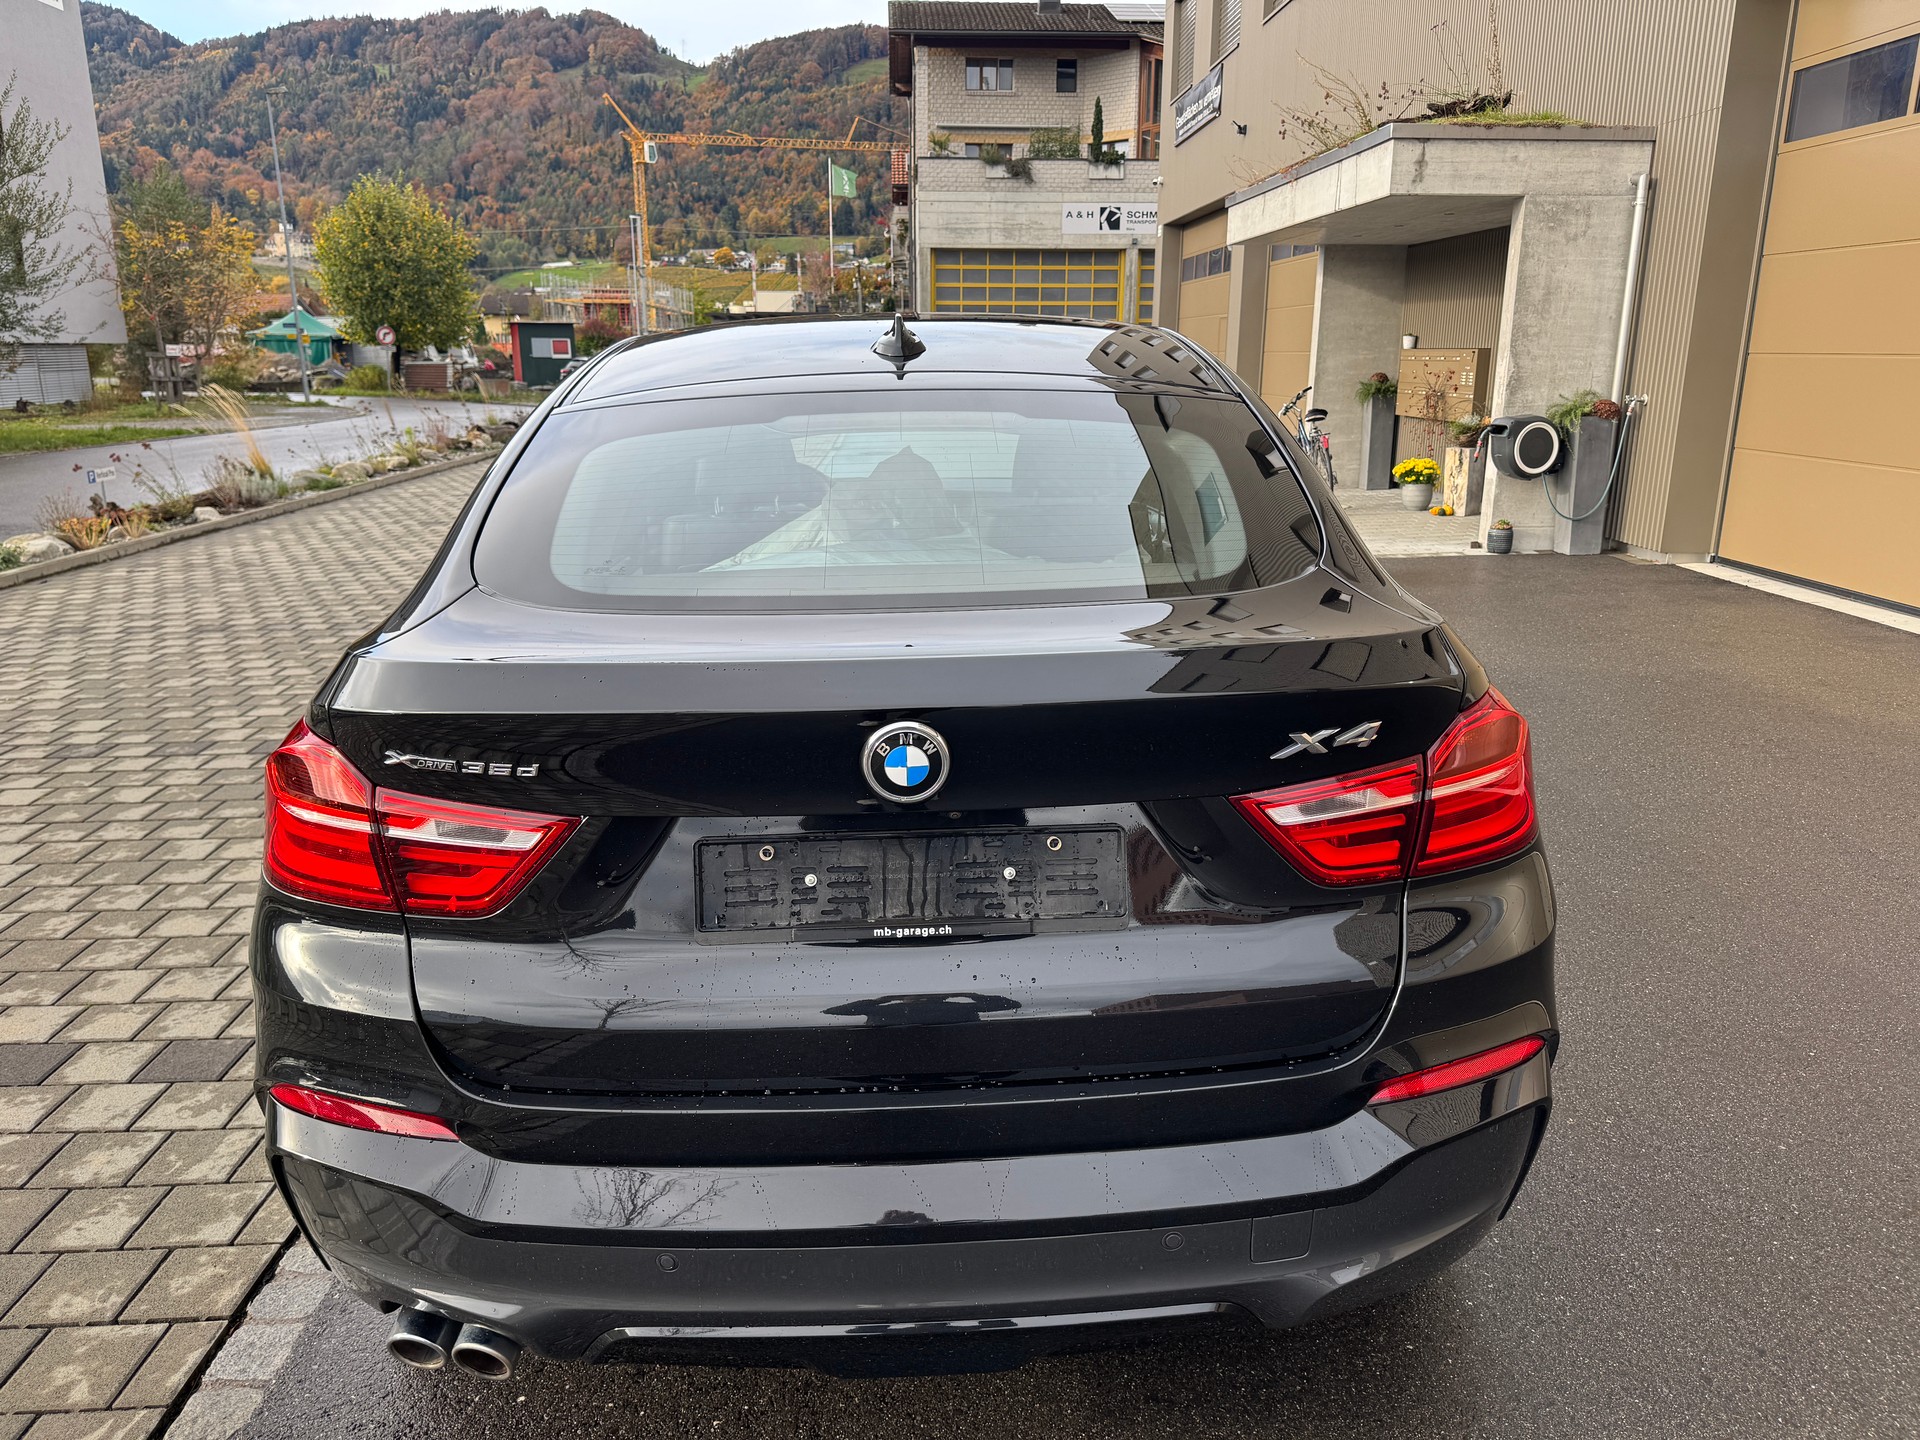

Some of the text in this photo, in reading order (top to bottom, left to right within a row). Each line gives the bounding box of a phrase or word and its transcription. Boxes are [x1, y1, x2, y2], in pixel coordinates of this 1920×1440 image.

[1066, 211, 1094, 219] A & H
[876, 732, 938, 758] BMW
[1269, 720, 1383, 760] X4
[873, 925, 953, 938] mb-garage.ch
